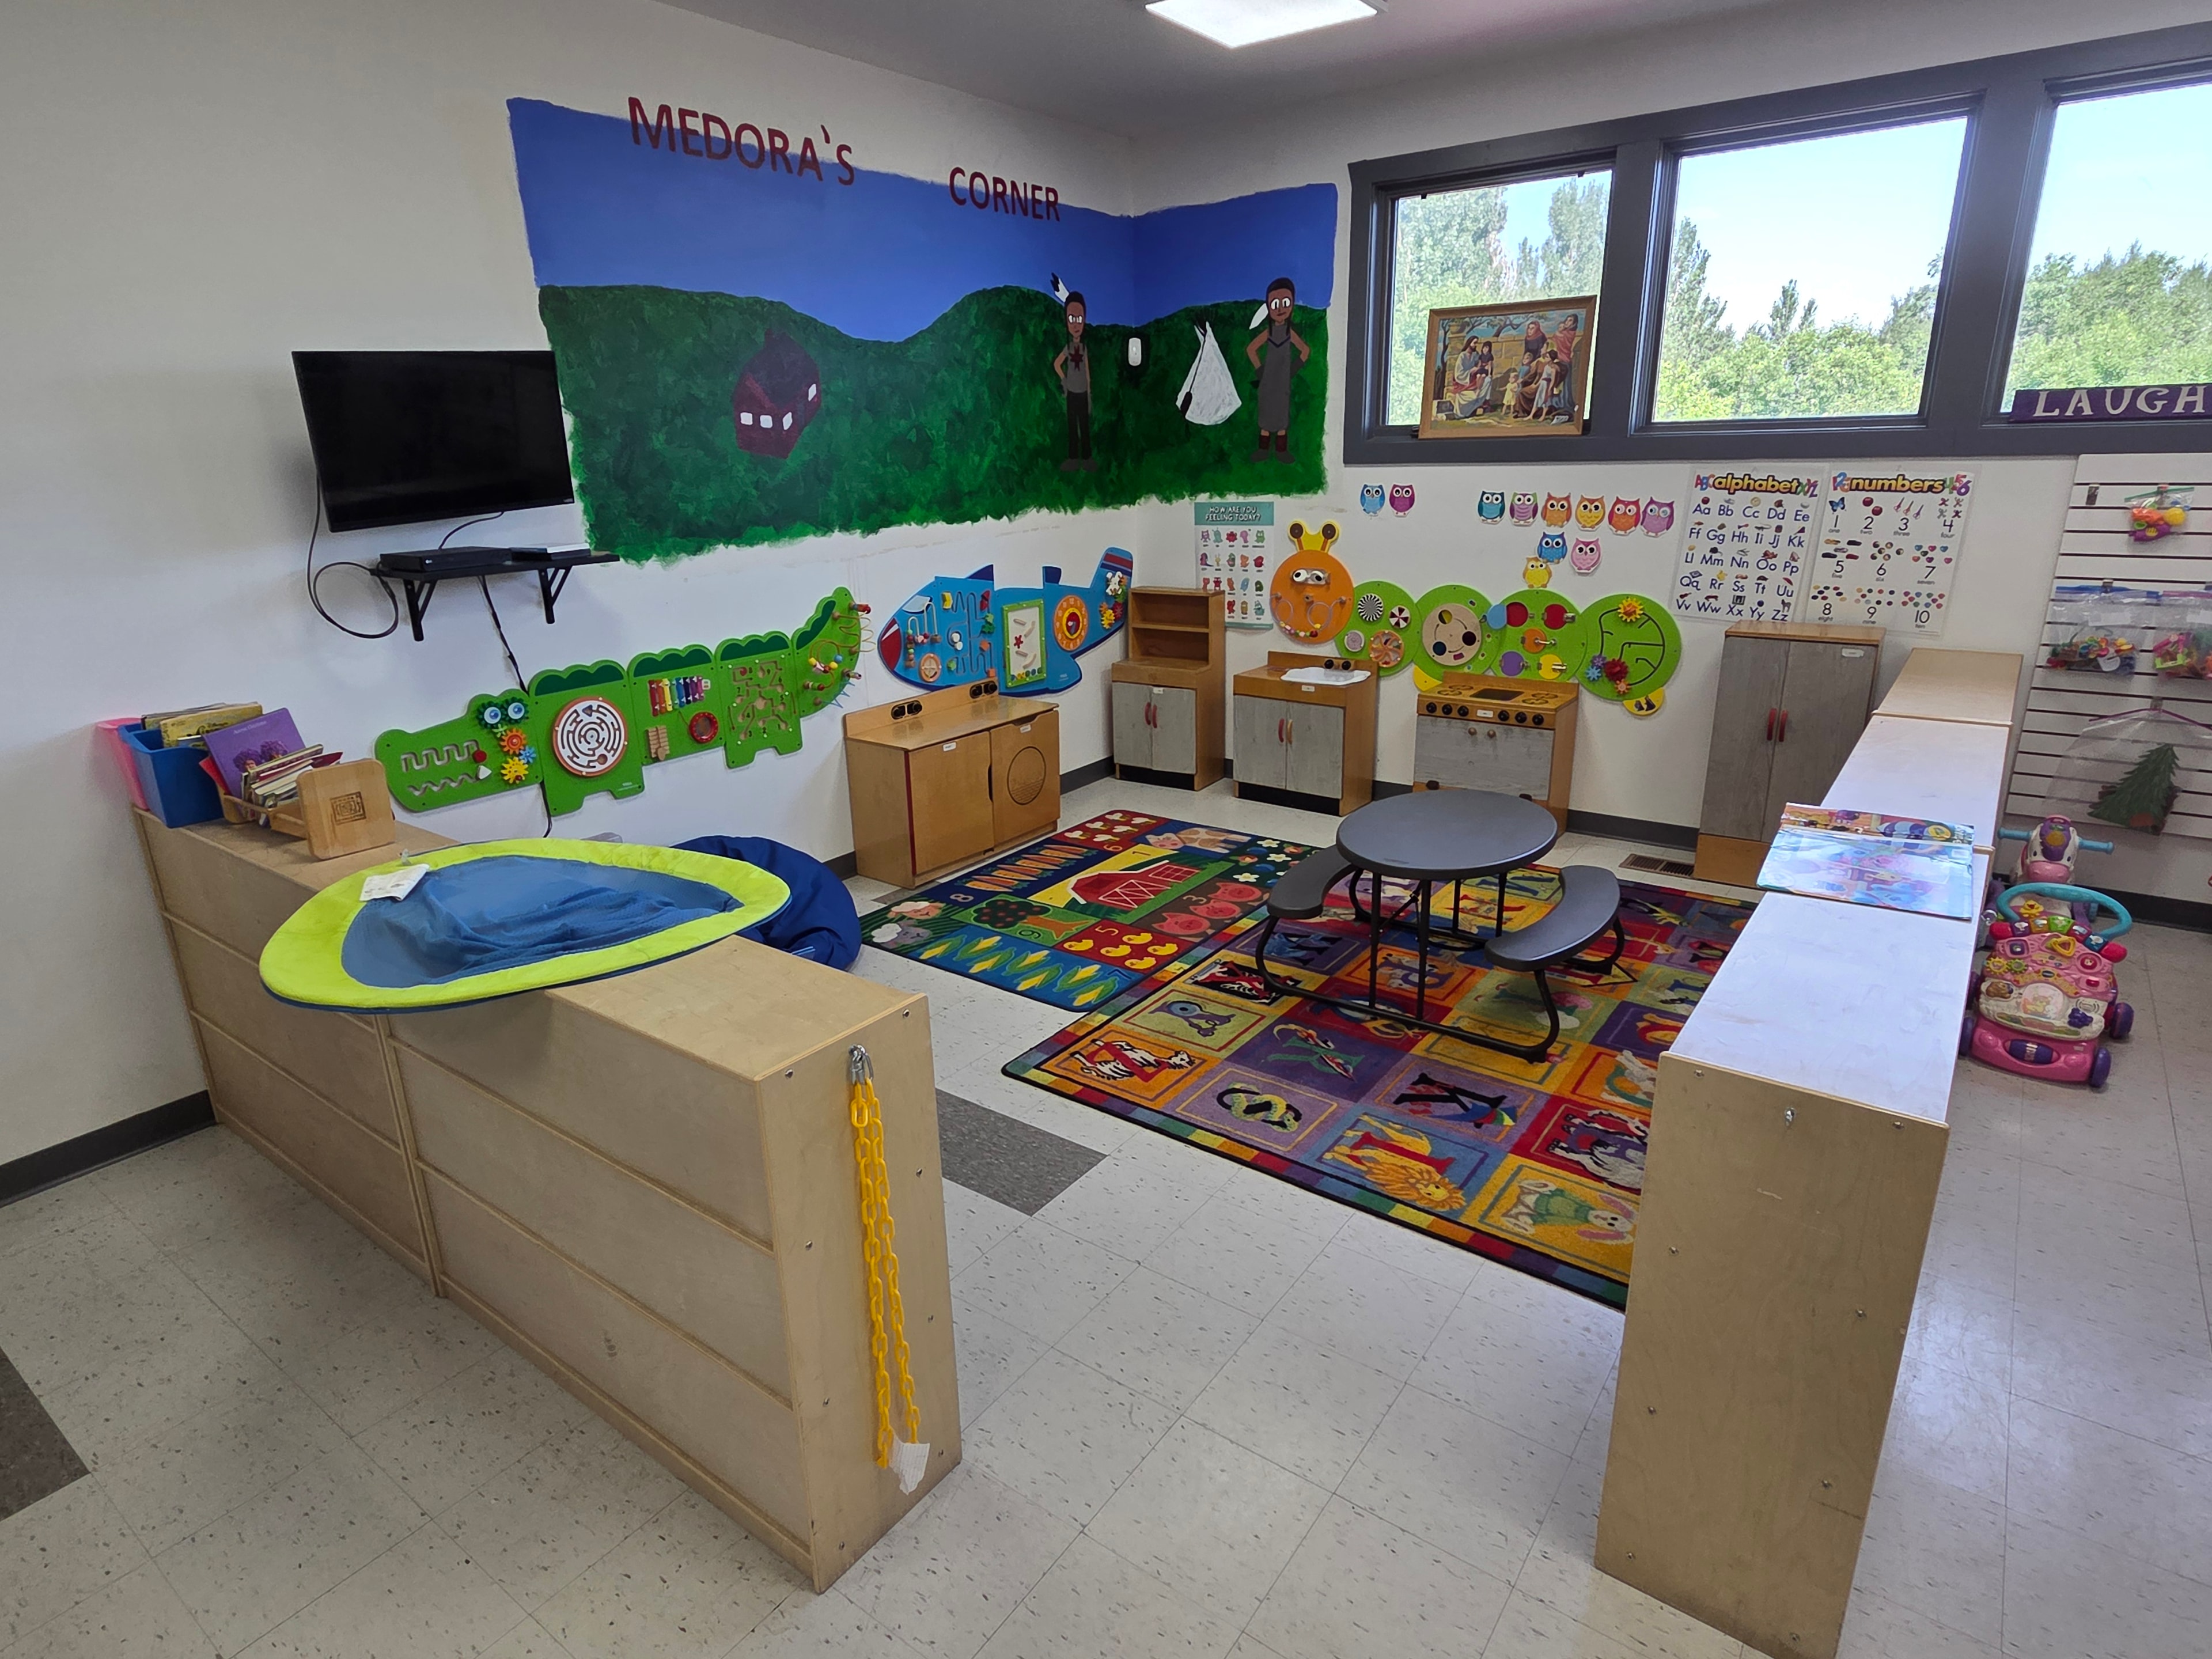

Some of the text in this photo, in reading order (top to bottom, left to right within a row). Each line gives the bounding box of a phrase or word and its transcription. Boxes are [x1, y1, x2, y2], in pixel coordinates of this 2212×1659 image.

[628, 96, 1060, 222] MEDORA'S CORNER
[2033, 385, 2207, 416] LAUGH
[1713, 473, 1800, 495] alphabet
[1851, 474, 1946, 494] numbers
[1692, 504, 1810, 522] Aa Bb Cc Dd Ee
[1834, 515, 1953, 532] 1 2 3 4
[1689, 528, 1701, 539] Ff
[1706, 529, 1725, 544] Gg
[1731, 531, 1748, 543] Hh
[1768, 535, 1780, 548] Jj
[1787, 536, 1805, 547] Kk
[1700, 554, 1724, 566] Mm
[1730, 557, 1749, 569] Nn
[1756, 559, 1777, 571] Oo
[1783, 561, 1798, 575] Pp
[1834, 560, 1936, 579] 5 6 7
[1680, 576, 1794, 597] Qq Rr Ss Tt Uu
[1676, 599, 1788, 622] Vv Ww Xx Yy Zz
[1823, 603, 1930, 623] 8 9 10
[950, 893, 974, 902] 8
